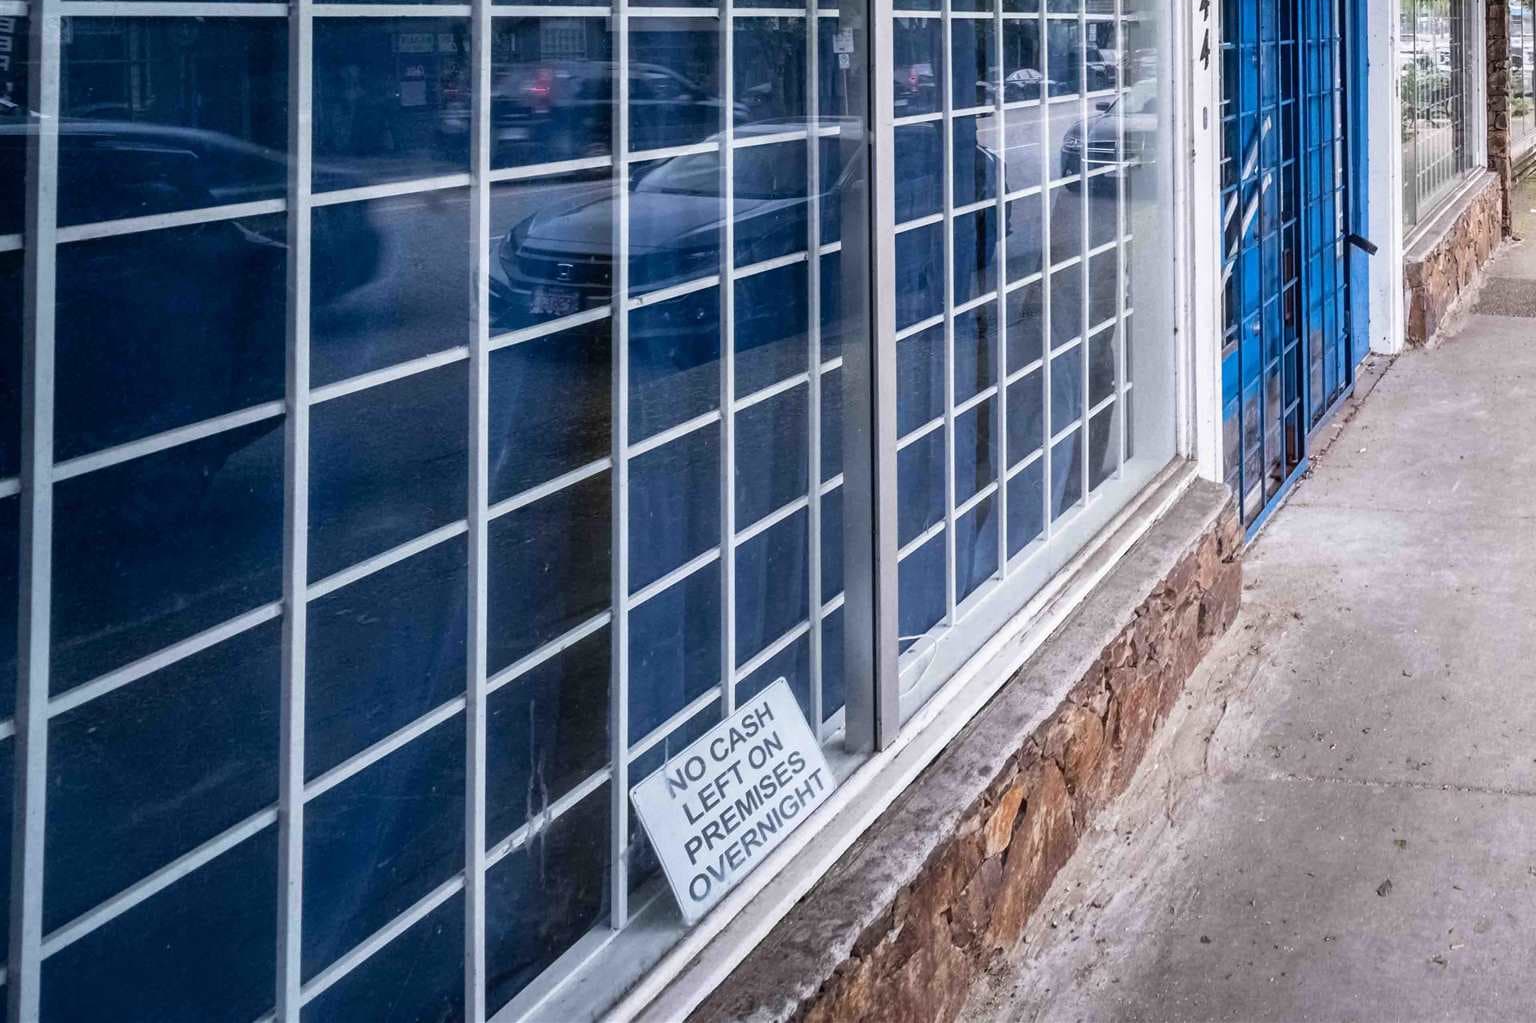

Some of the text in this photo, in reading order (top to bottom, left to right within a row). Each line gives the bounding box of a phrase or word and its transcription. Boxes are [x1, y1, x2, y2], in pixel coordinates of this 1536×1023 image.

[665, 701, 775, 799] NO CASH
[682, 731, 784, 826] LEFT ON
[683, 750, 807, 866] PREMISES
[688, 767, 825, 903] OVERNIGHT
